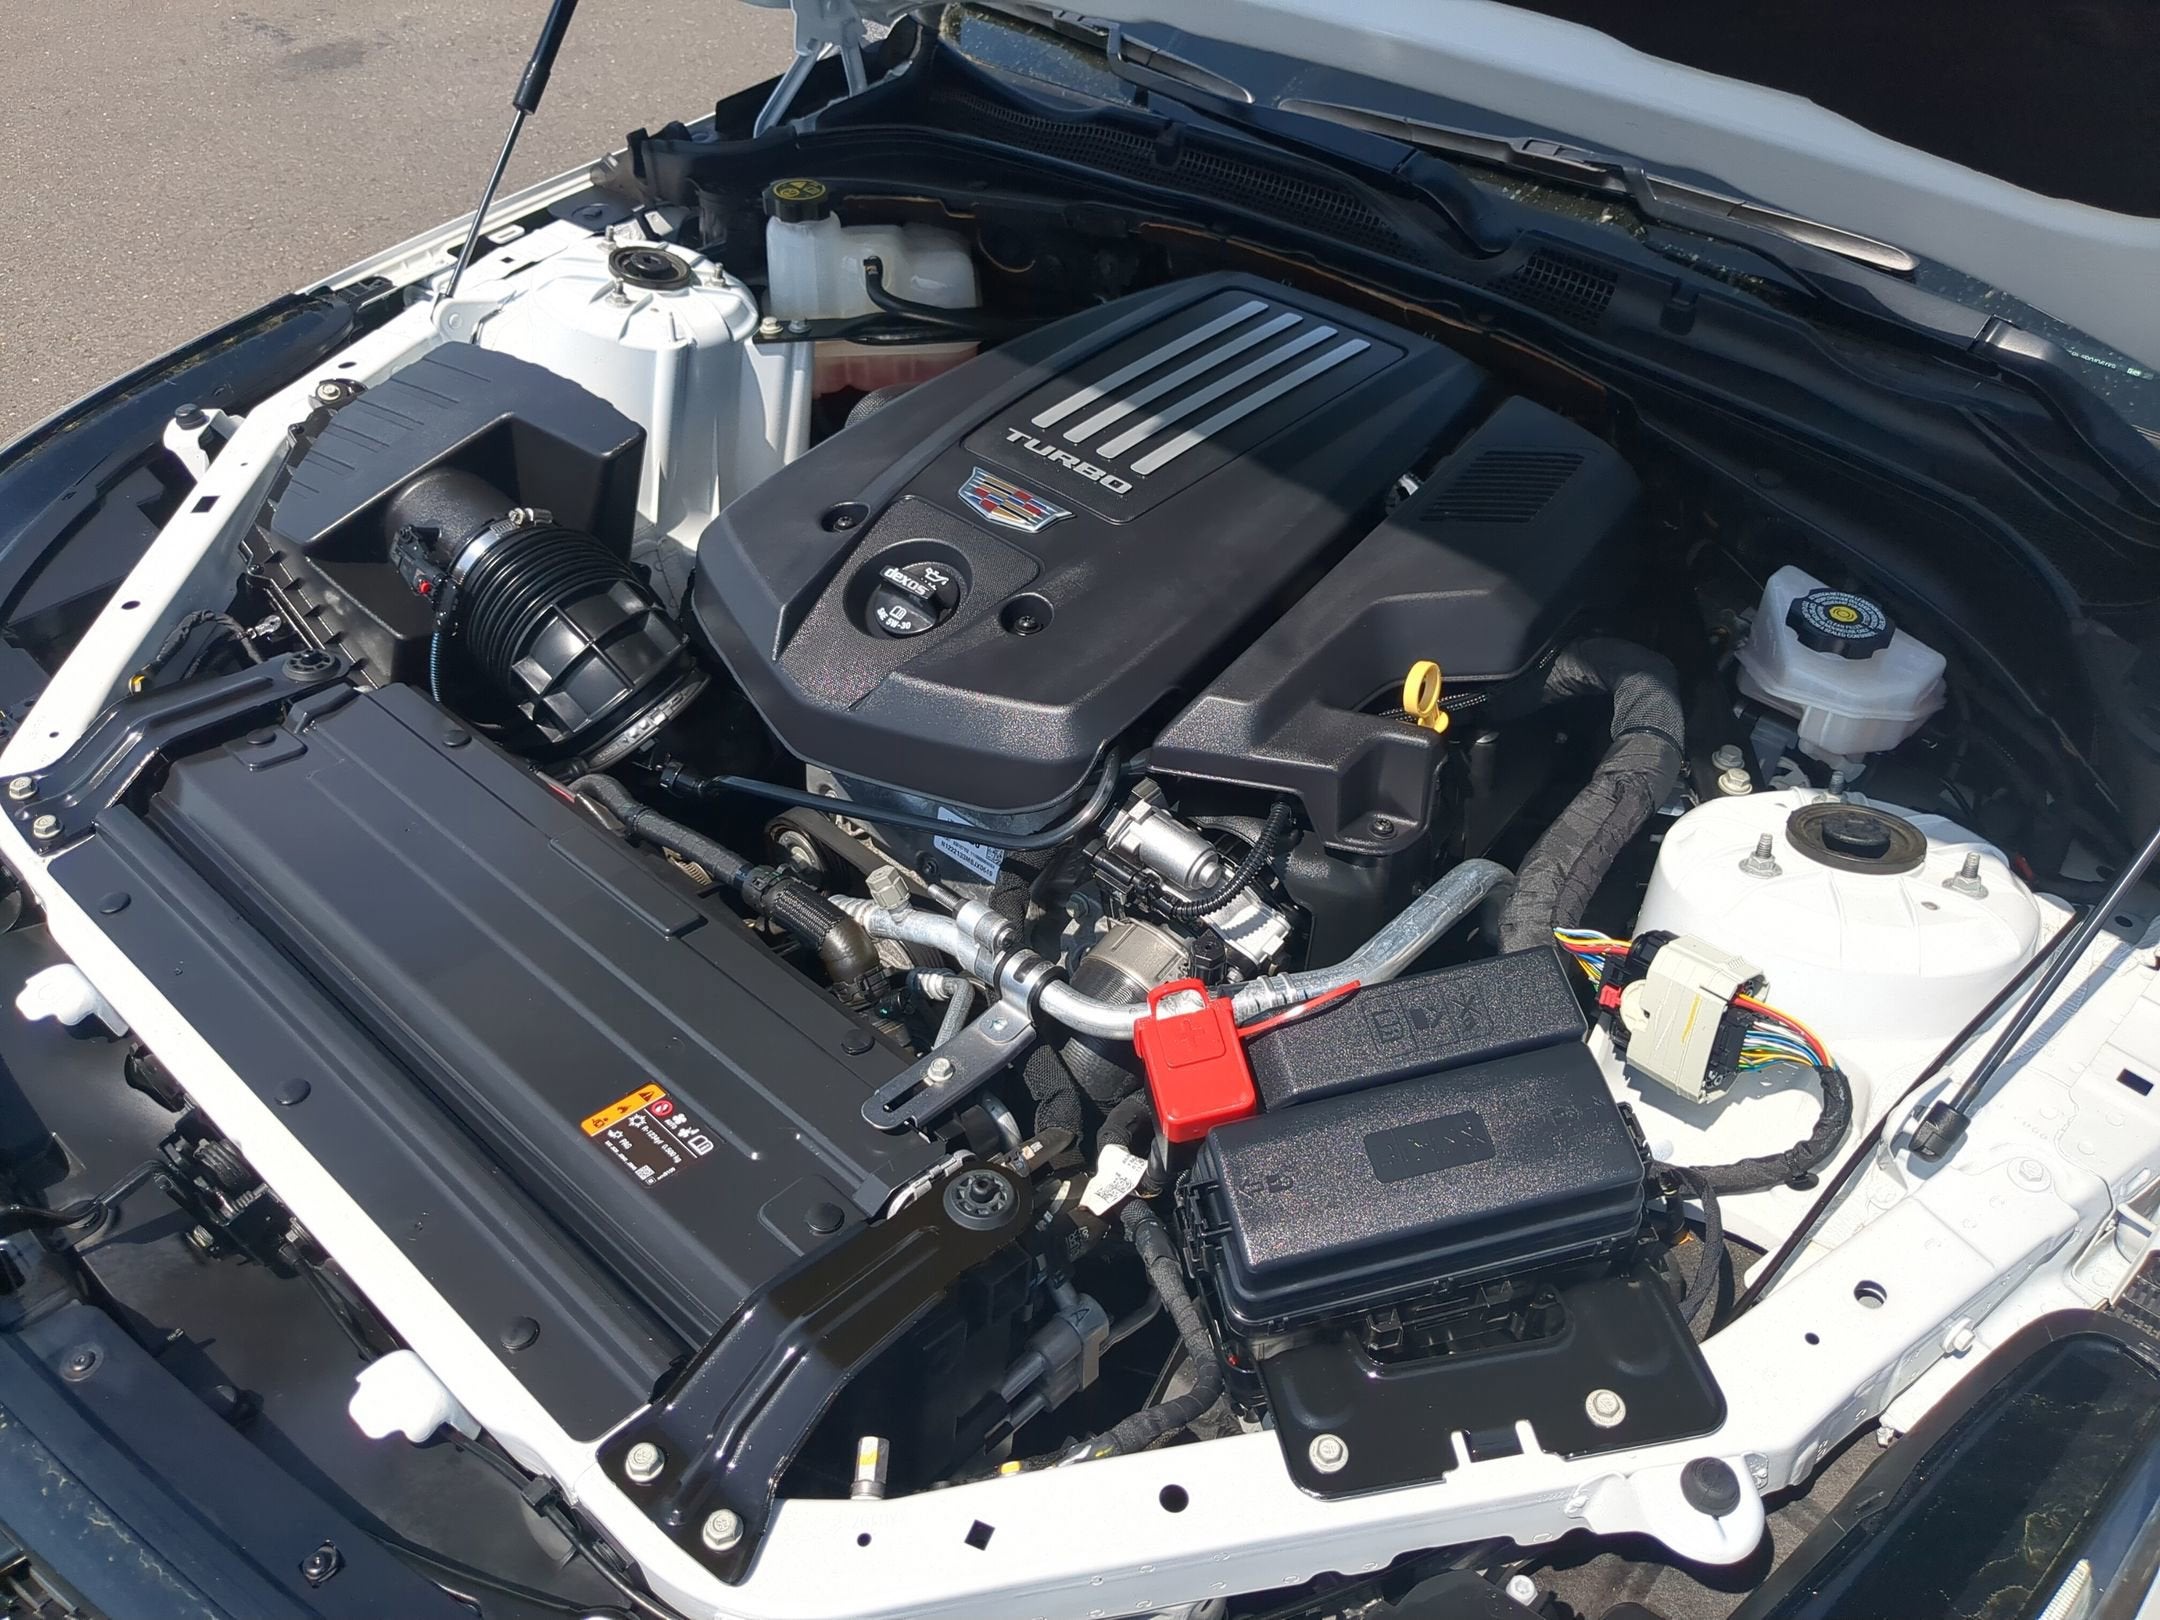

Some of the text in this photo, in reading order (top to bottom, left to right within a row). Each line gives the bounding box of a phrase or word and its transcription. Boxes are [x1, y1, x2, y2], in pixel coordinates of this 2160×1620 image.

[1005, 427, 1133, 495] TURBO
[884, 567, 929, 596] dexos
[885, 617, 912, 630] 5W-30
[618, 1138, 633, 1150] PAG
[641, 1125, 665, 1145] R-1234yf
